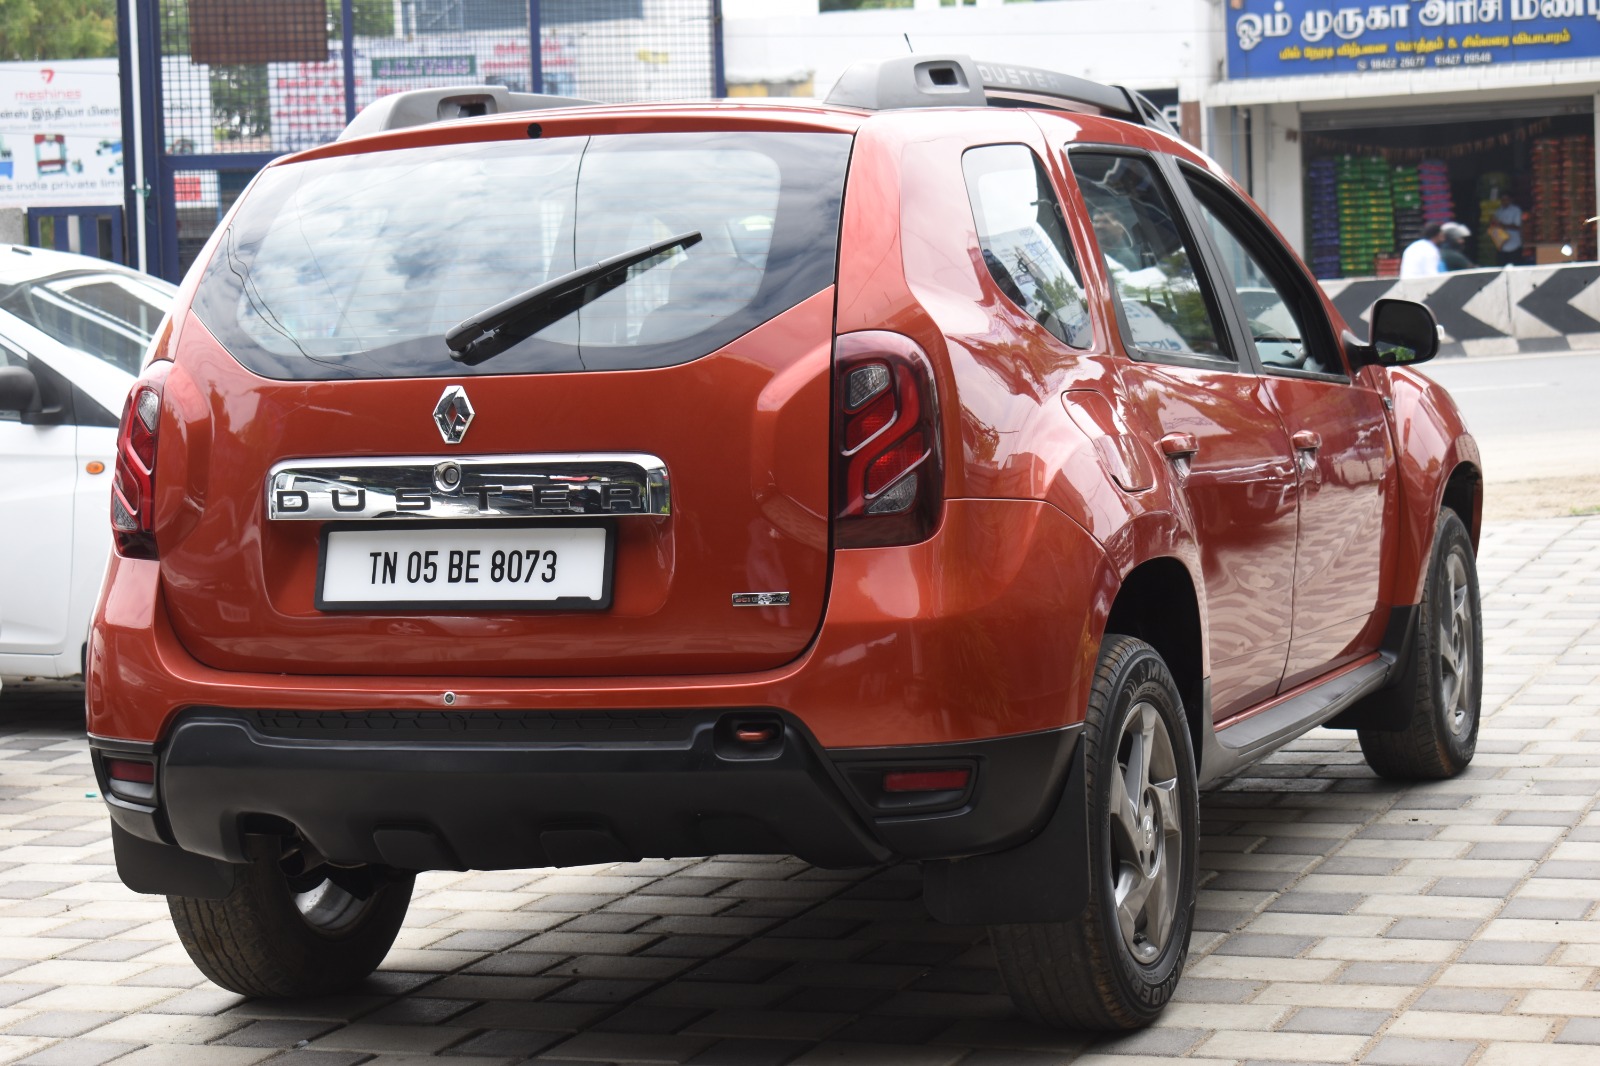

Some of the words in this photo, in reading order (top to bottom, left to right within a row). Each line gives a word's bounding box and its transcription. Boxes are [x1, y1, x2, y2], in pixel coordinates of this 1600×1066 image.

[1236, 0, 1293, 50] ஓம்
[1300, 4, 1410, 42] முருகா
[976, 65, 1060, 89] DUSTER
[15, 88, 82, 101] meshines
[17, 179, 48, 191] india
[51, 177, 97, 192] private
[276, 483, 642, 513] DUSTER
[369, 551, 398, 585] TN
[406, 550, 437, 584] 05
[447, 550, 481, 584] BE
[490, 549, 558, 584] 8073
